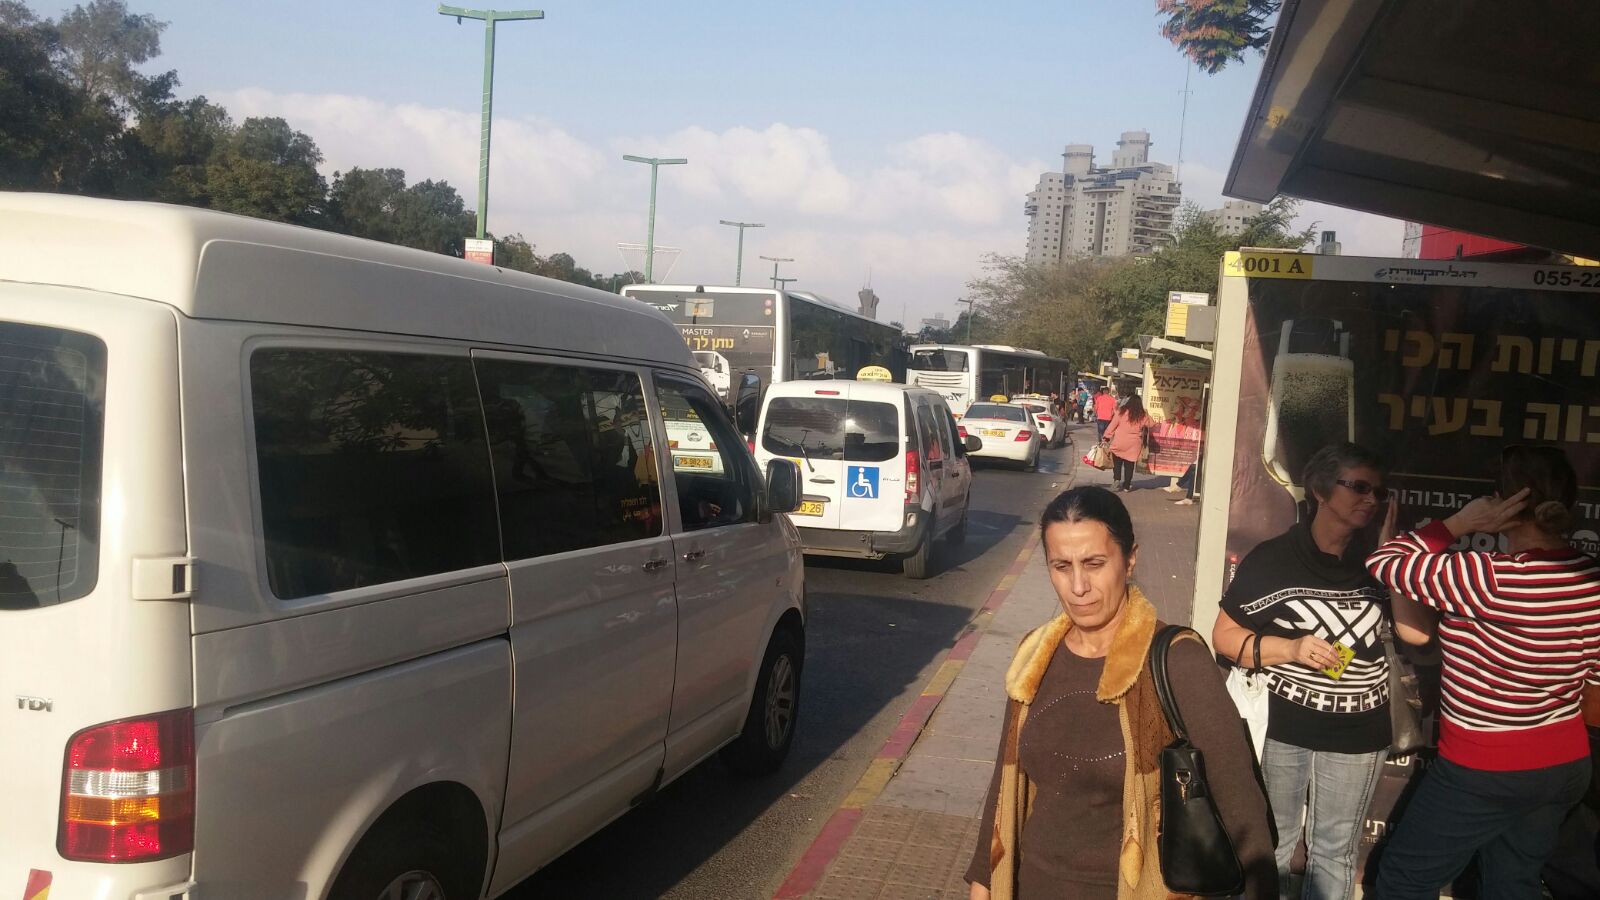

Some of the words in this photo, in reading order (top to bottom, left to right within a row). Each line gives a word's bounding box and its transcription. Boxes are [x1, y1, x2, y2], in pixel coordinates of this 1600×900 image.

[1227, 257, 1281, 273] 4001
[1287, 258, 1305, 274] A
[682, 328, 714, 336] MASTER
[692, 335, 708, 351] לך
[711, 336, 735, 351] נותן
[1384, 329, 1475, 370] הכי
[1377, 393, 1504, 437] בעיר
